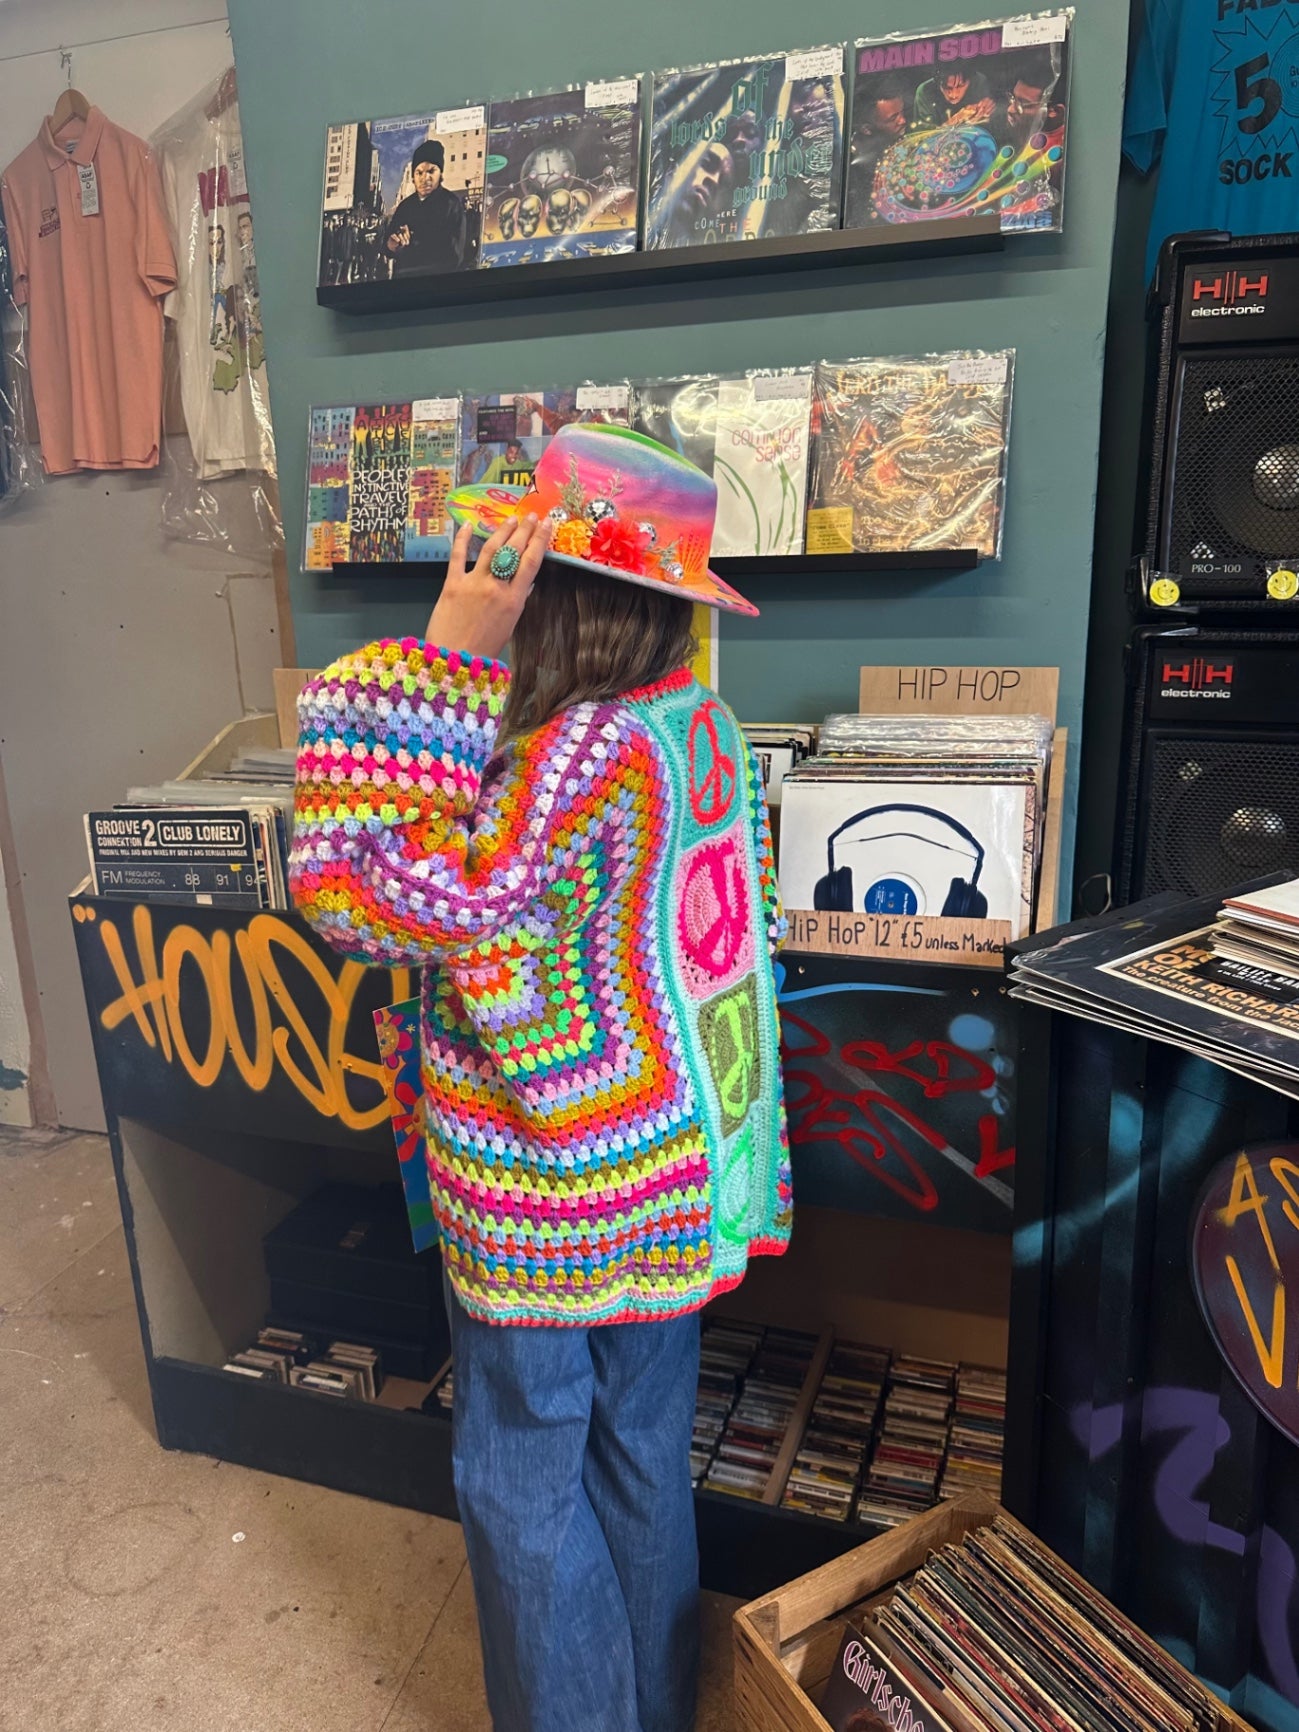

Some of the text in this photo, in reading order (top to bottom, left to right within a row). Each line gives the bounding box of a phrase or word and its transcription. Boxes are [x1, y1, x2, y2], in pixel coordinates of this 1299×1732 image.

[858, 41, 936, 74] MAIN
[938, 31, 1002, 62] SOU
[731, 61, 775, 126] of
[1234, 51, 1283, 135] 5
[670, 111, 728, 147] lords
[765, 115, 796, 144] the
[1219, 152, 1295, 185] SOCK
[720, 218, 752, 233] THE
[1191, 304, 1265, 317] electronic
[353, 482, 409, 494] NSTINCTIVE
[352, 491, 409, 506] TRAVELS
[351, 504, 396, 518] PATHS
[350, 517, 408, 532] RHYTHM
[898, 668, 1021, 702] HIP HOP
[1161, 688, 1231, 699] electronic
[95, 820, 140, 835] GROOVE
[142, 819, 157, 847] 2
[162, 825, 241, 841] CLUB LONELY
[98, 837, 142, 847] CONNEKTION
[101, 870, 123, 884] FM
[124, 870, 161, 878] FREQUENCY
[185, 873, 201, 886] 88
[216, 874, 230, 886] 91
[901, 921, 924, 949] £5
[925, 934, 960, 951] unless
[1153, 953, 1200, 969] OF
[1132, 960, 1205, 985] KEITH
[1200, 983, 1299, 1022] RICHAR
